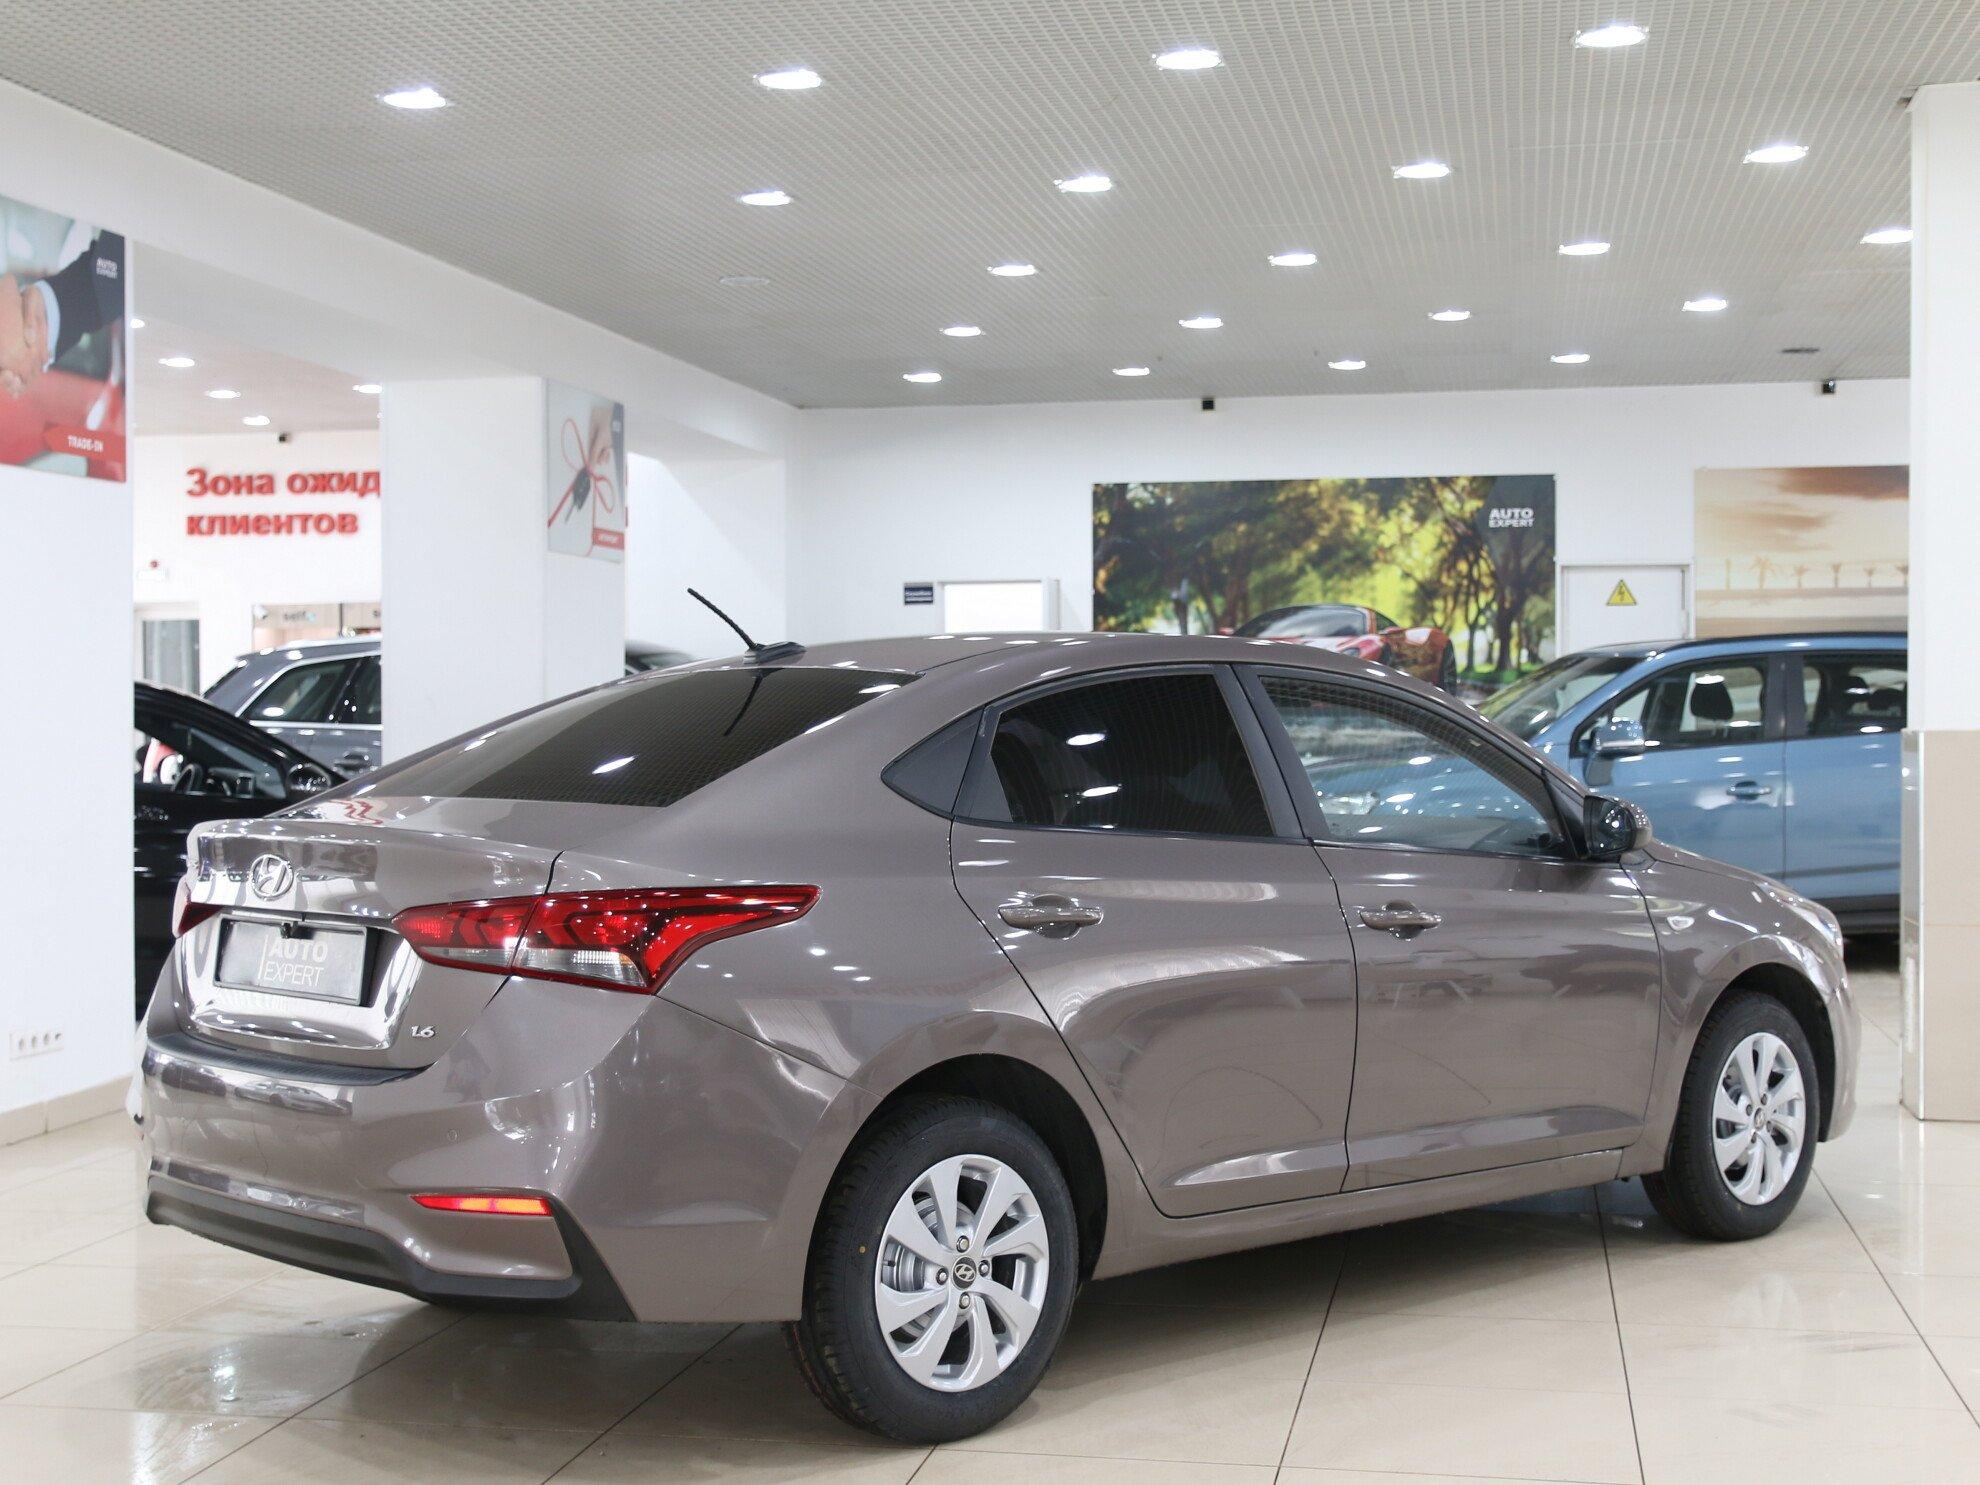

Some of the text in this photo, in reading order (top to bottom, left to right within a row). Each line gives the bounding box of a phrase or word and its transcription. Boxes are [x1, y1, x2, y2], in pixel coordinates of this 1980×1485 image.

[186, 467, 275, 497] Зона
[186, 513, 358, 536] клиентов
[1489, 507, 1534, 520] AUTO
[1489, 518, 1534, 528] EXPERT
[268, 938, 329, 963] AUTO
[263, 961, 325, 987] EXPERT
